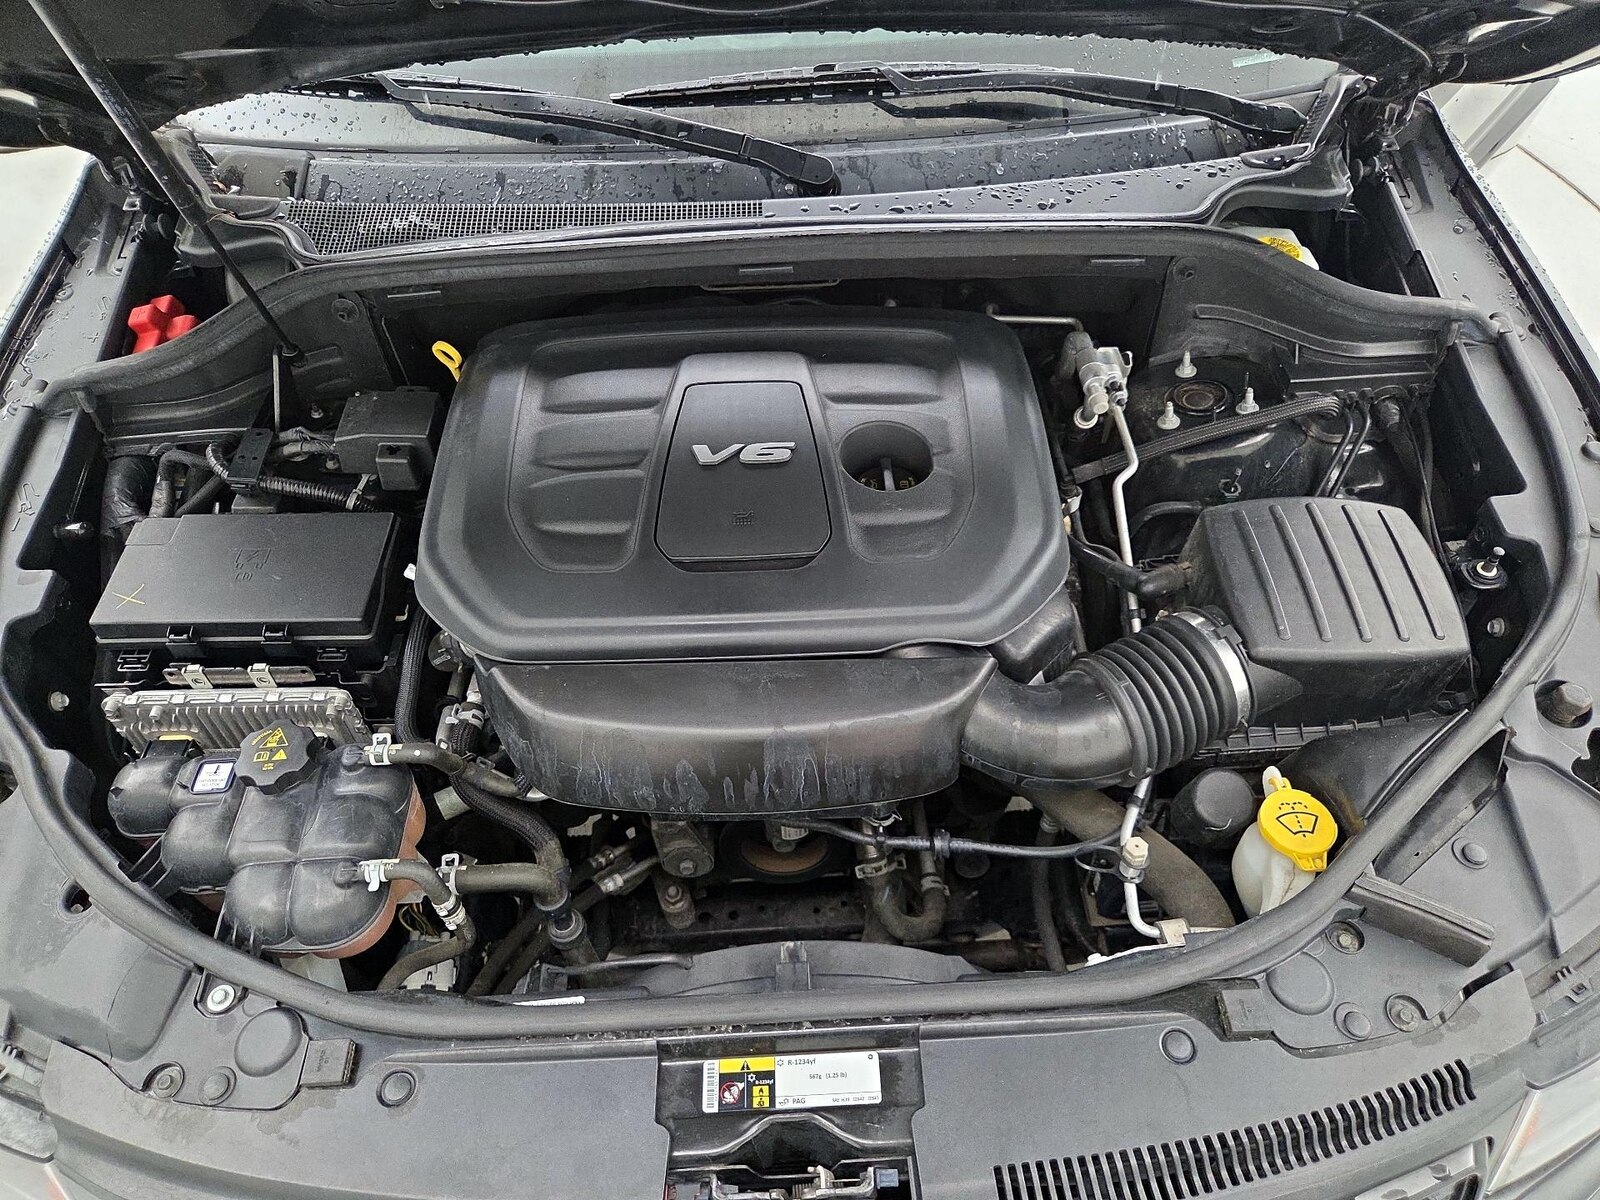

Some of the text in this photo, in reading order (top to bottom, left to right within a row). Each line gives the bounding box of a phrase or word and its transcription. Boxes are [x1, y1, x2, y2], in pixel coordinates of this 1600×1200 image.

[692, 442, 796, 465] V6
[787, 1058, 816, 1066] R-1234yf
[792, 1097, 806, 1105] PAG
